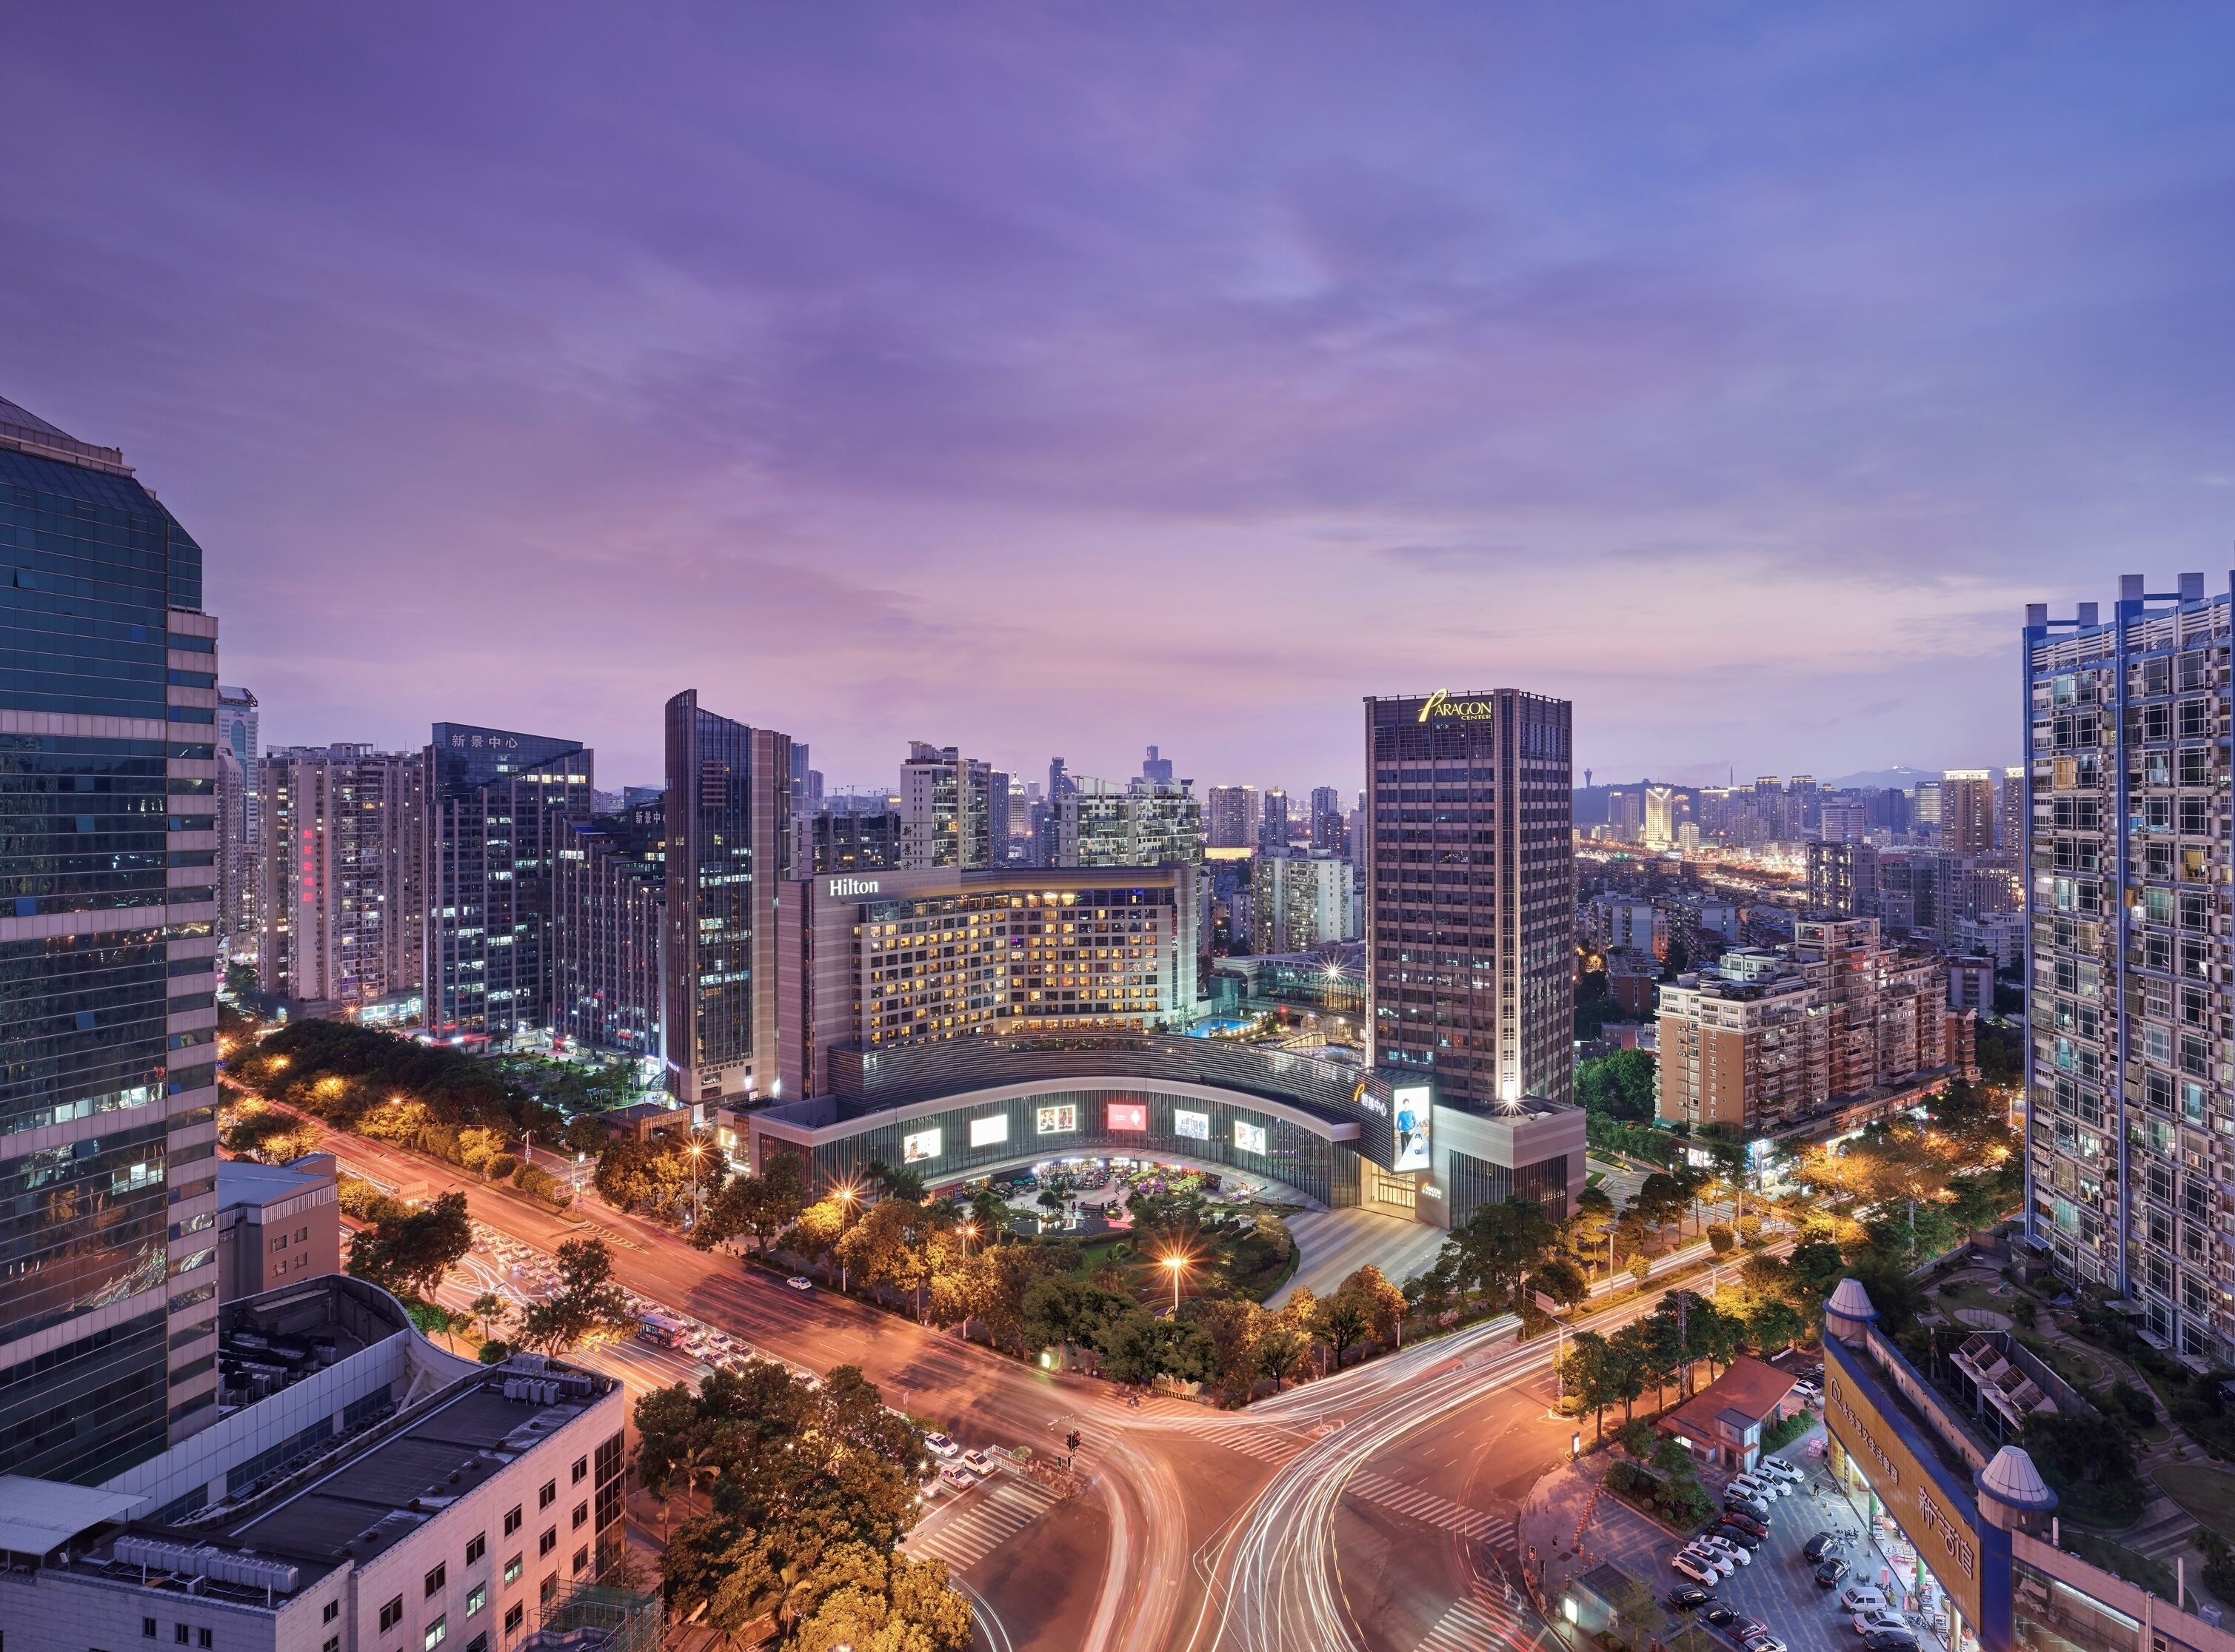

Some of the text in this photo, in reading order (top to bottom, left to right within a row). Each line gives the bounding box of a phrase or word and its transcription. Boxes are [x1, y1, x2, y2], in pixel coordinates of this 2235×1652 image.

[1417, 688, 1491, 722] PARAGON
[451, 734, 518, 749] 新景中心
[829, 878, 878, 896] Hilton
